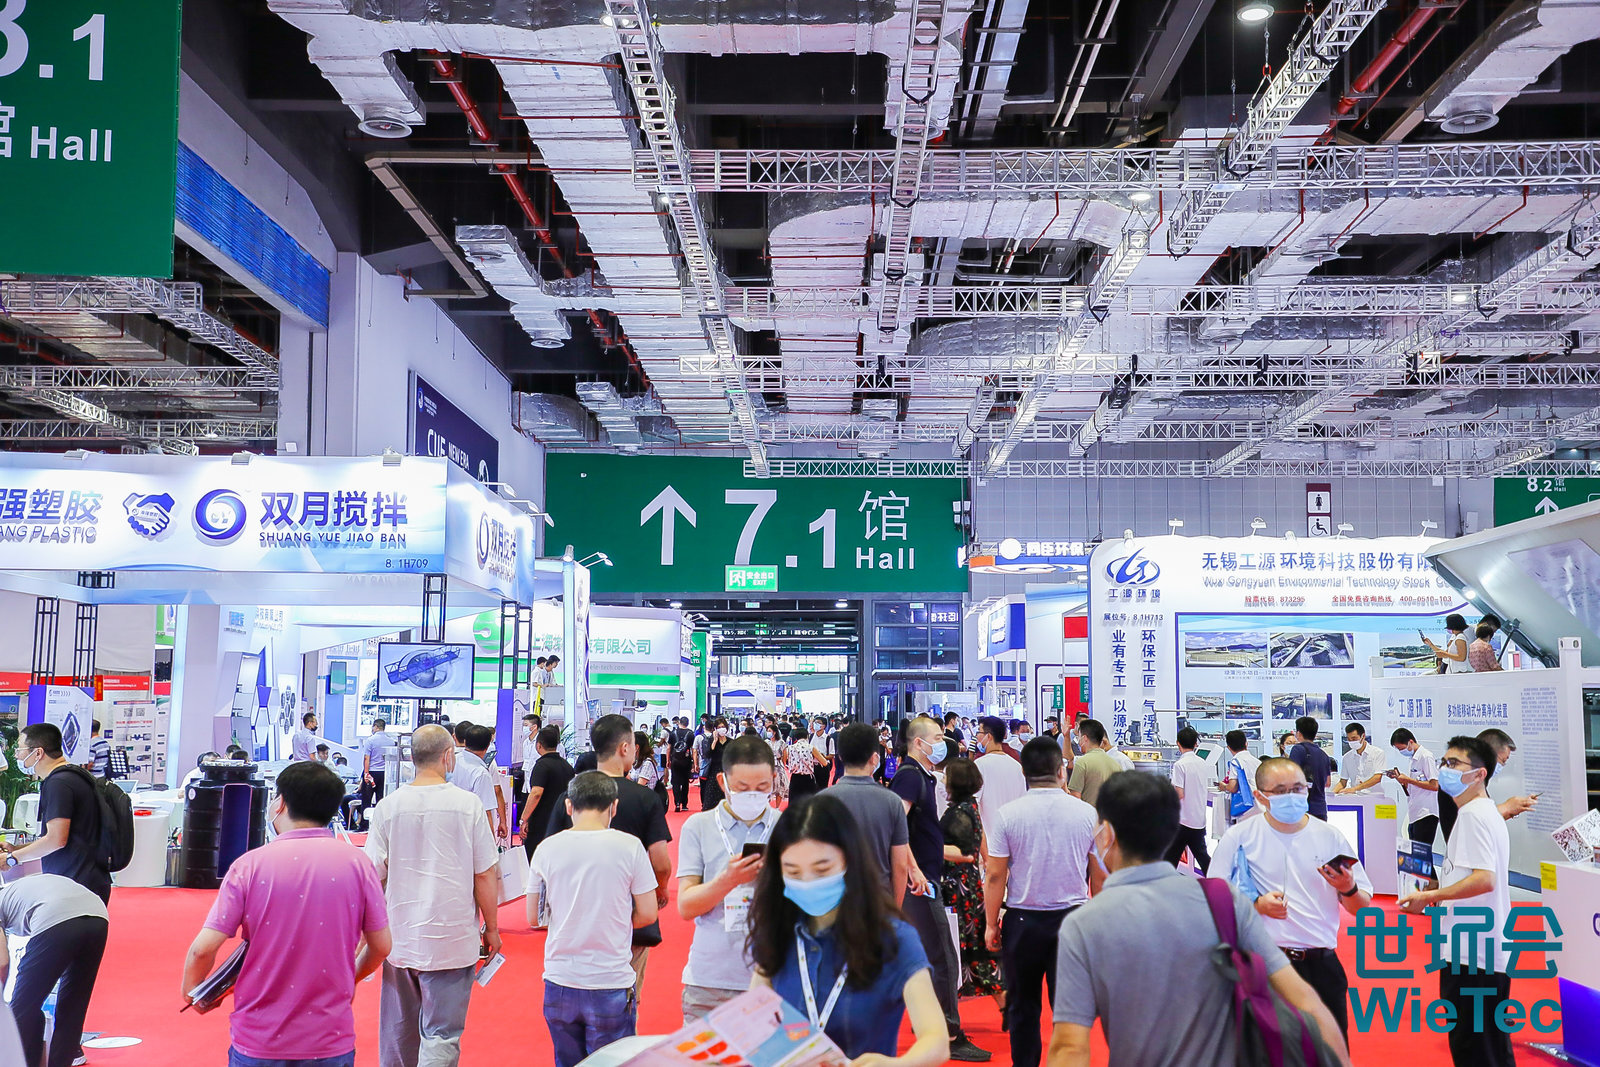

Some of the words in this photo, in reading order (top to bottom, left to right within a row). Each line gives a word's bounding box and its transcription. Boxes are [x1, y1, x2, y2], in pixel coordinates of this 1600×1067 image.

[30, 126, 112, 162] Hall
[1527, 477, 1552, 492] 8.2
[259, 491, 407, 527] 双月搅拌
[858, 490, 910, 541] 馆
[31, 525, 97, 539] PLASTIC
[259, 532, 311, 543] SHUANG
[317, 533, 341, 543] YUE
[346, 533, 374, 543] JIAO
[380, 533, 406, 543] BAN
[725, 489, 836, 568] 7.1
[856, 547, 914, 569] Hall
[746, 571, 774, 579] 安全出口
[1347, 576, 1400, 590] Technology
[1403, 576, 1430, 587] Stock
[1108, 588, 1160, 598] 工源环境
[1112, 629, 1127, 688] 业有专工
[1142, 629, 1156, 688] 环保工匠
[1399, 698, 1432, 718] 工源环境
